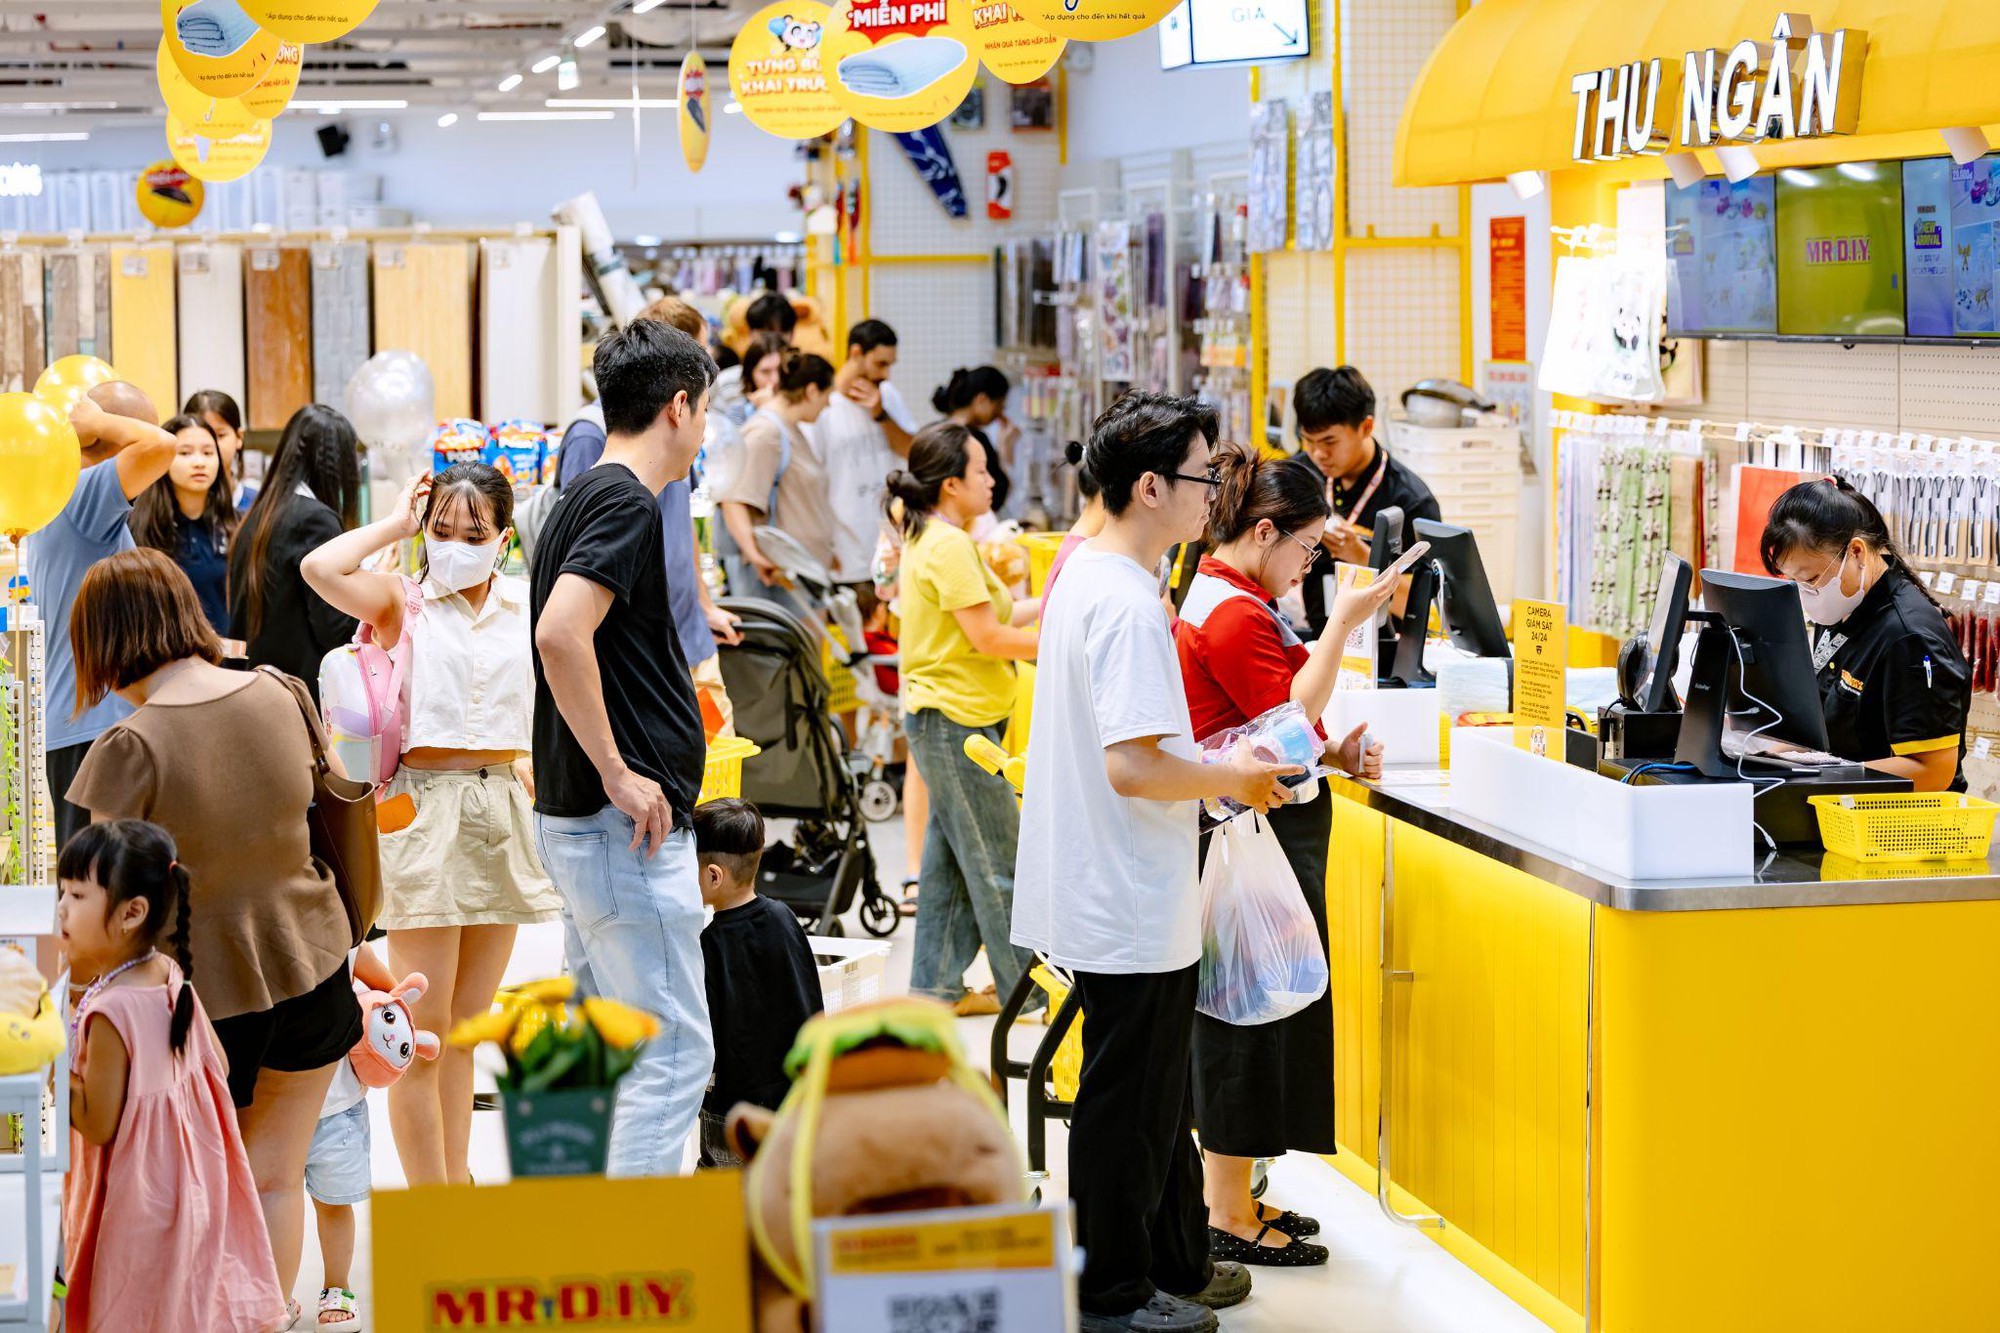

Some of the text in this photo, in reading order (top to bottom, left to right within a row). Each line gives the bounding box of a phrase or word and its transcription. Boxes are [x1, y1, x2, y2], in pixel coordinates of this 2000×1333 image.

[853, 0, 906, 28] MIỄN
[973, 3, 1008, 29] KHAI
[740, 76, 784, 96] KHAI
[1571, 12, 1847, 161] THU NGÂN
[1806, 240, 1833, 263] MR
[1527, 606, 1552, 618] CAMERA
[1531, 632, 1548, 642] 24/24
[433, 1287, 536, 1326] MR
